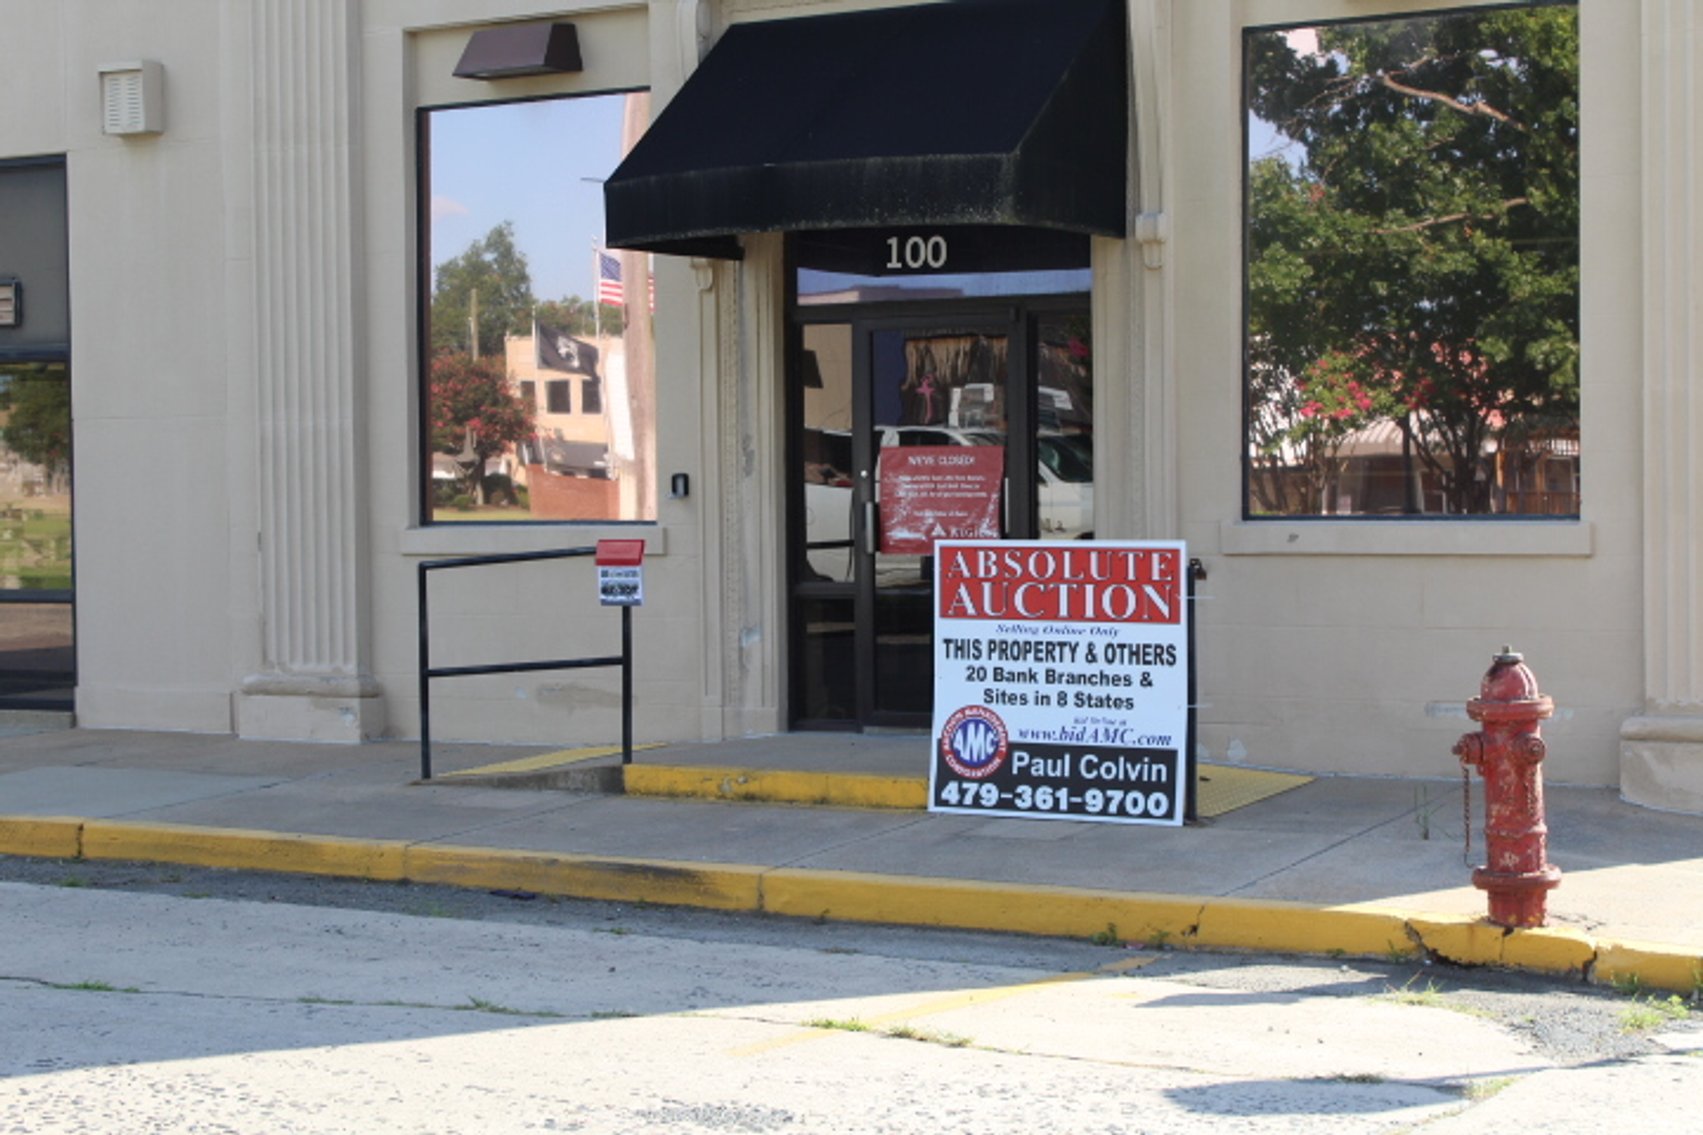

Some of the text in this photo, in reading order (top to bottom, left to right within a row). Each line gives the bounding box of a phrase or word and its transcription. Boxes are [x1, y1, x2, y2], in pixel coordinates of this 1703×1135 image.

[886, 236, 947, 269] 100
[948, 549, 1174, 582] ABSOLUTE
[947, 581, 1173, 620] AUCTION
[996, 623, 1120, 639] Selling Online Only
[943, 638, 1177, 666] THIS PROPERTY & OTHERS
[965, 666, 1154, 688] 20 Bank Branches &
[983, 688, 1135, 710] Sites in 8 States
[953, 721, 998, 763] AMC
[1018, 725, 1172, 746] www.bidAMC.com
[1011, 752, 1168, 783] Paul Colvin
[941, 780, 1169, 817] 479-361-9700
